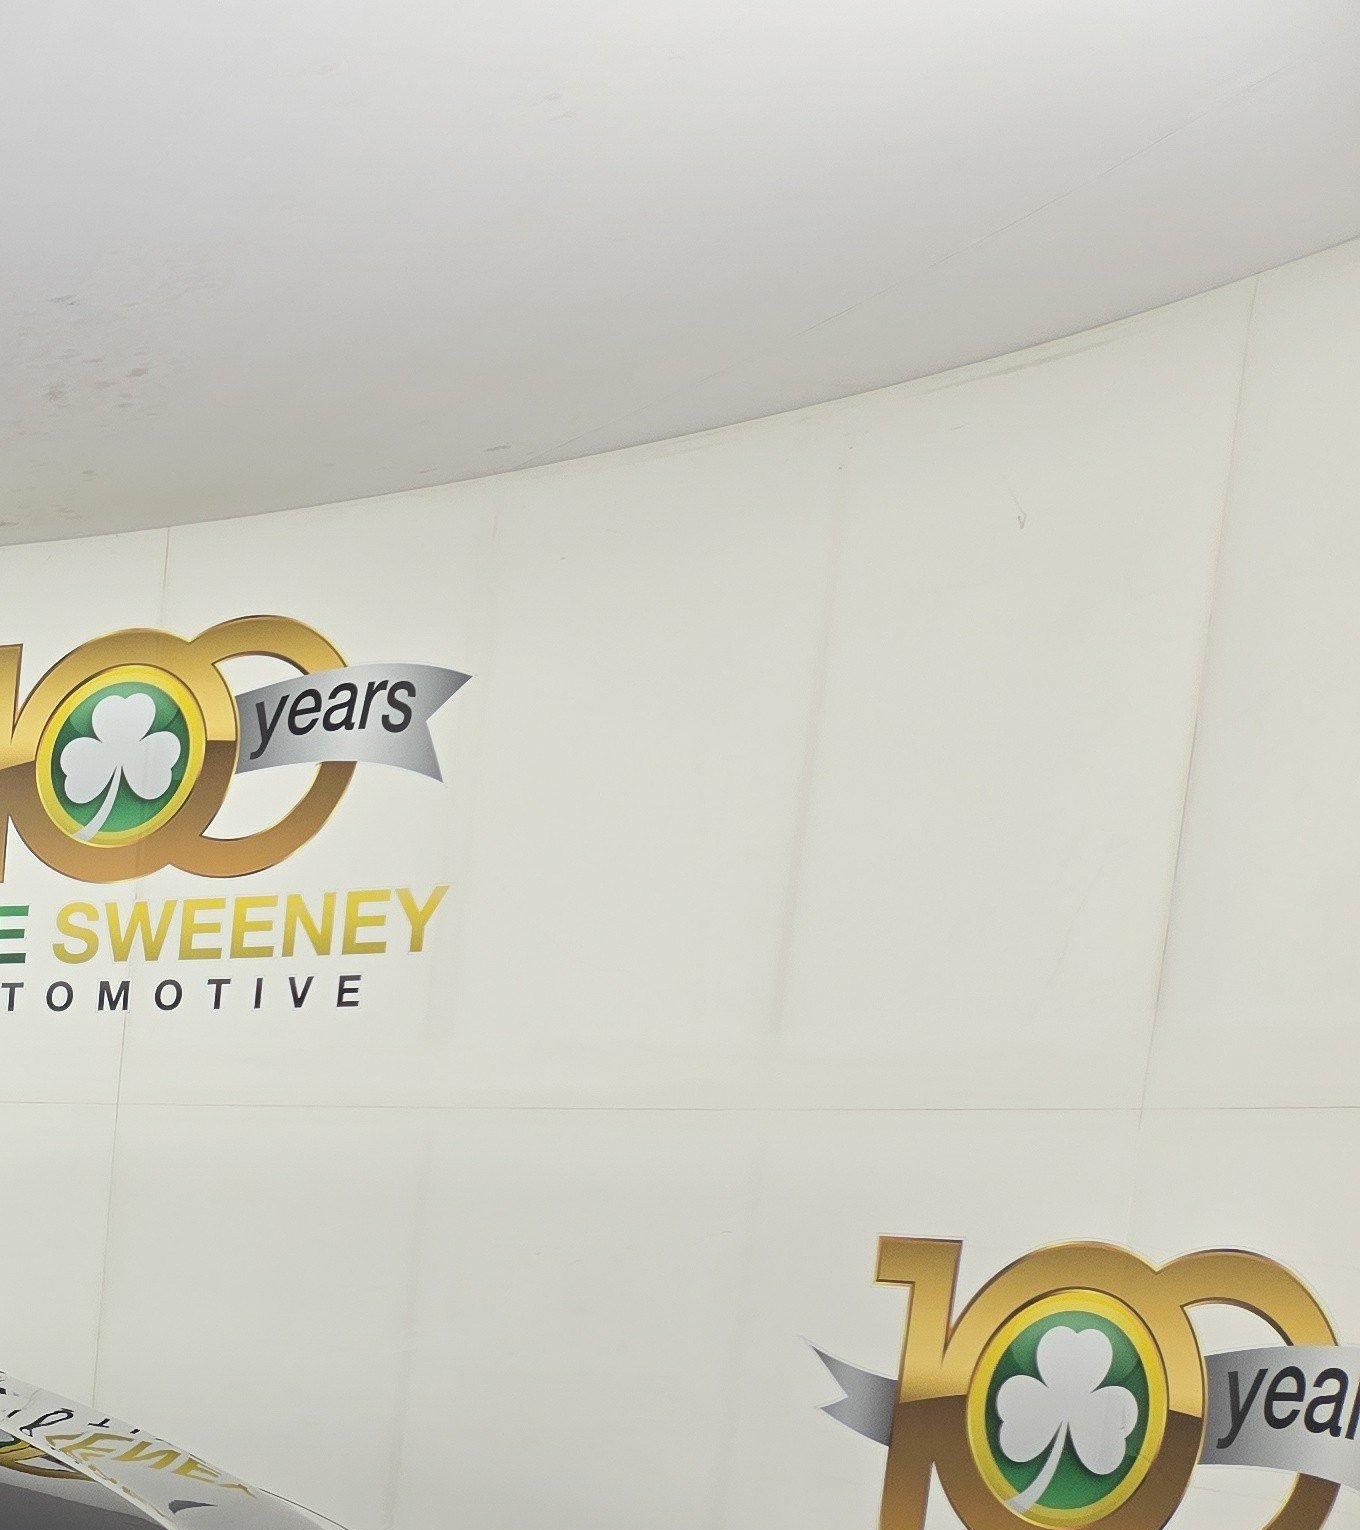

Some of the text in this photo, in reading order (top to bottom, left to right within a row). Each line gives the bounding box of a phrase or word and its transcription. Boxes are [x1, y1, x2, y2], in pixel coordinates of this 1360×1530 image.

[249, 672, 418, 760] years
[52, 885, 451, 965] SWEENEY
[1216, 1365, 1360, 1449] yea
